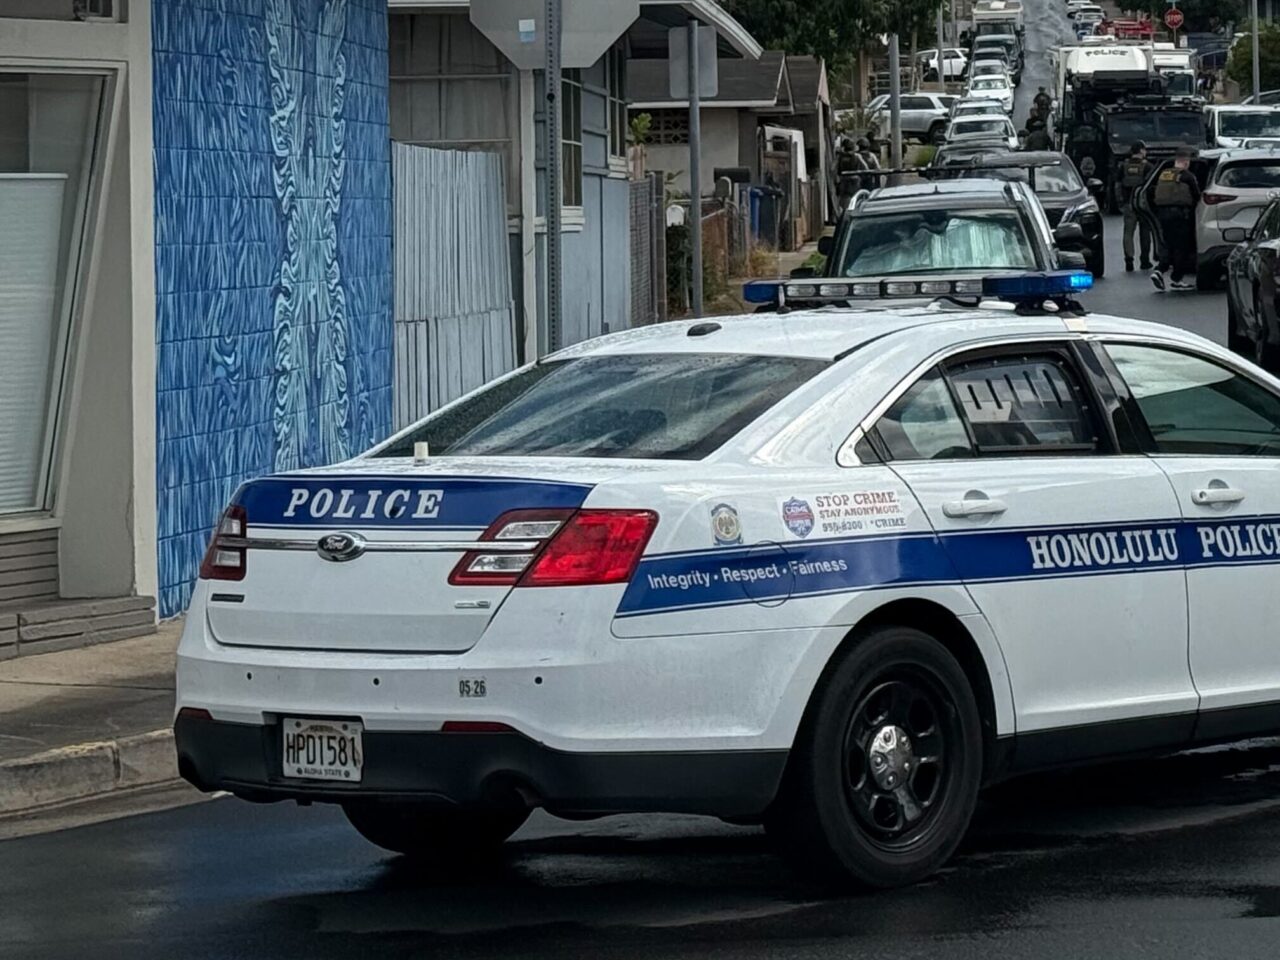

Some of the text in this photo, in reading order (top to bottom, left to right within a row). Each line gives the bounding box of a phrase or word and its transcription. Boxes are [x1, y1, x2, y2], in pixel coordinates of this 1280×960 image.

[1085, 49, 1129, 57] POLICE
[283, 488, 444, 519] POLICE
[815, 494, 850, 508] STOP
[819, 509, 842, 519] STAY
[324, 536, 347, 550] Ford
[1027, 528, 1179, 569] HONOLULU
[648, 558, 848, 591] Integrity Respect Fairness
[286, 732, 357, 767] HPD1581
